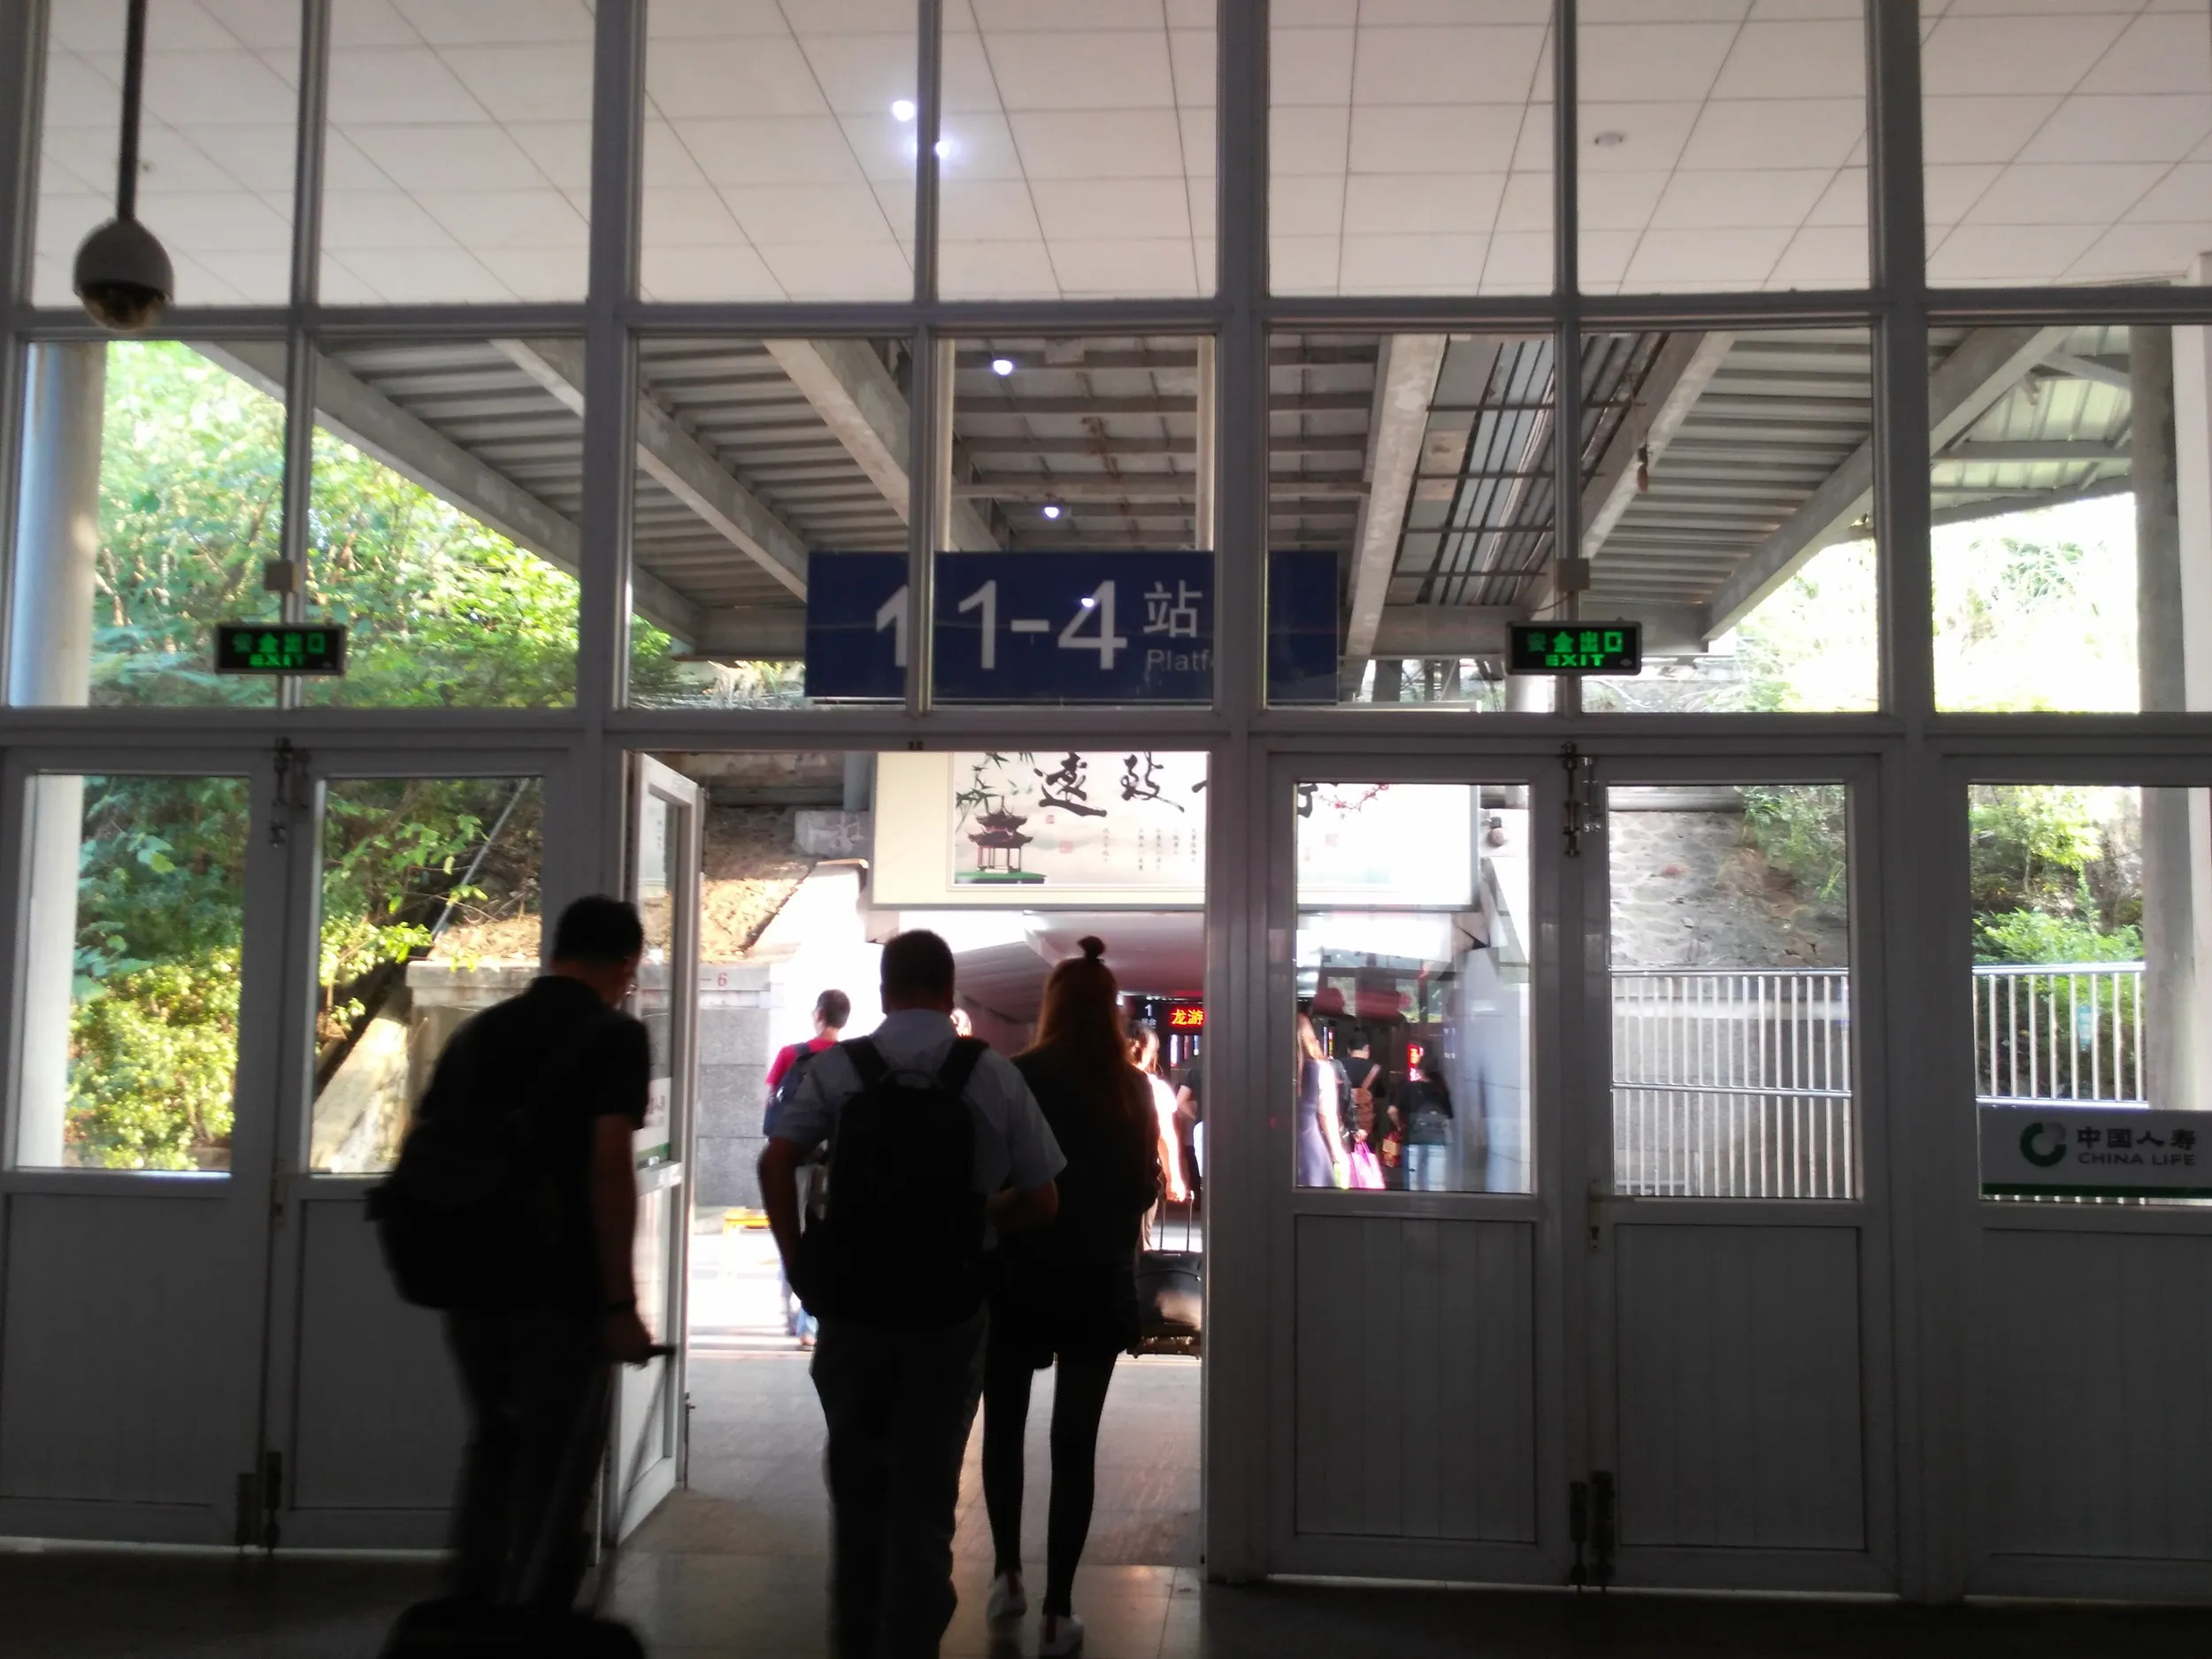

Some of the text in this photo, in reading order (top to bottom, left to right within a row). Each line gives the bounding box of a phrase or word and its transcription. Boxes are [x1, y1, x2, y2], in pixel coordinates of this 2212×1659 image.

[1526, 631, 1624, 653] 安全出口
[1147, 649, 1214, 672] Platf
[1545, 654, 1605, 666] EXIT
[1144, 1003, 1153, 1017] 1
[1171, 1009, 1204, 1025] 龙游
[2077, 1125, 2197, 1150] 中国人寿
[2078, 1153, 2196, 1166] CHINA LIFE
